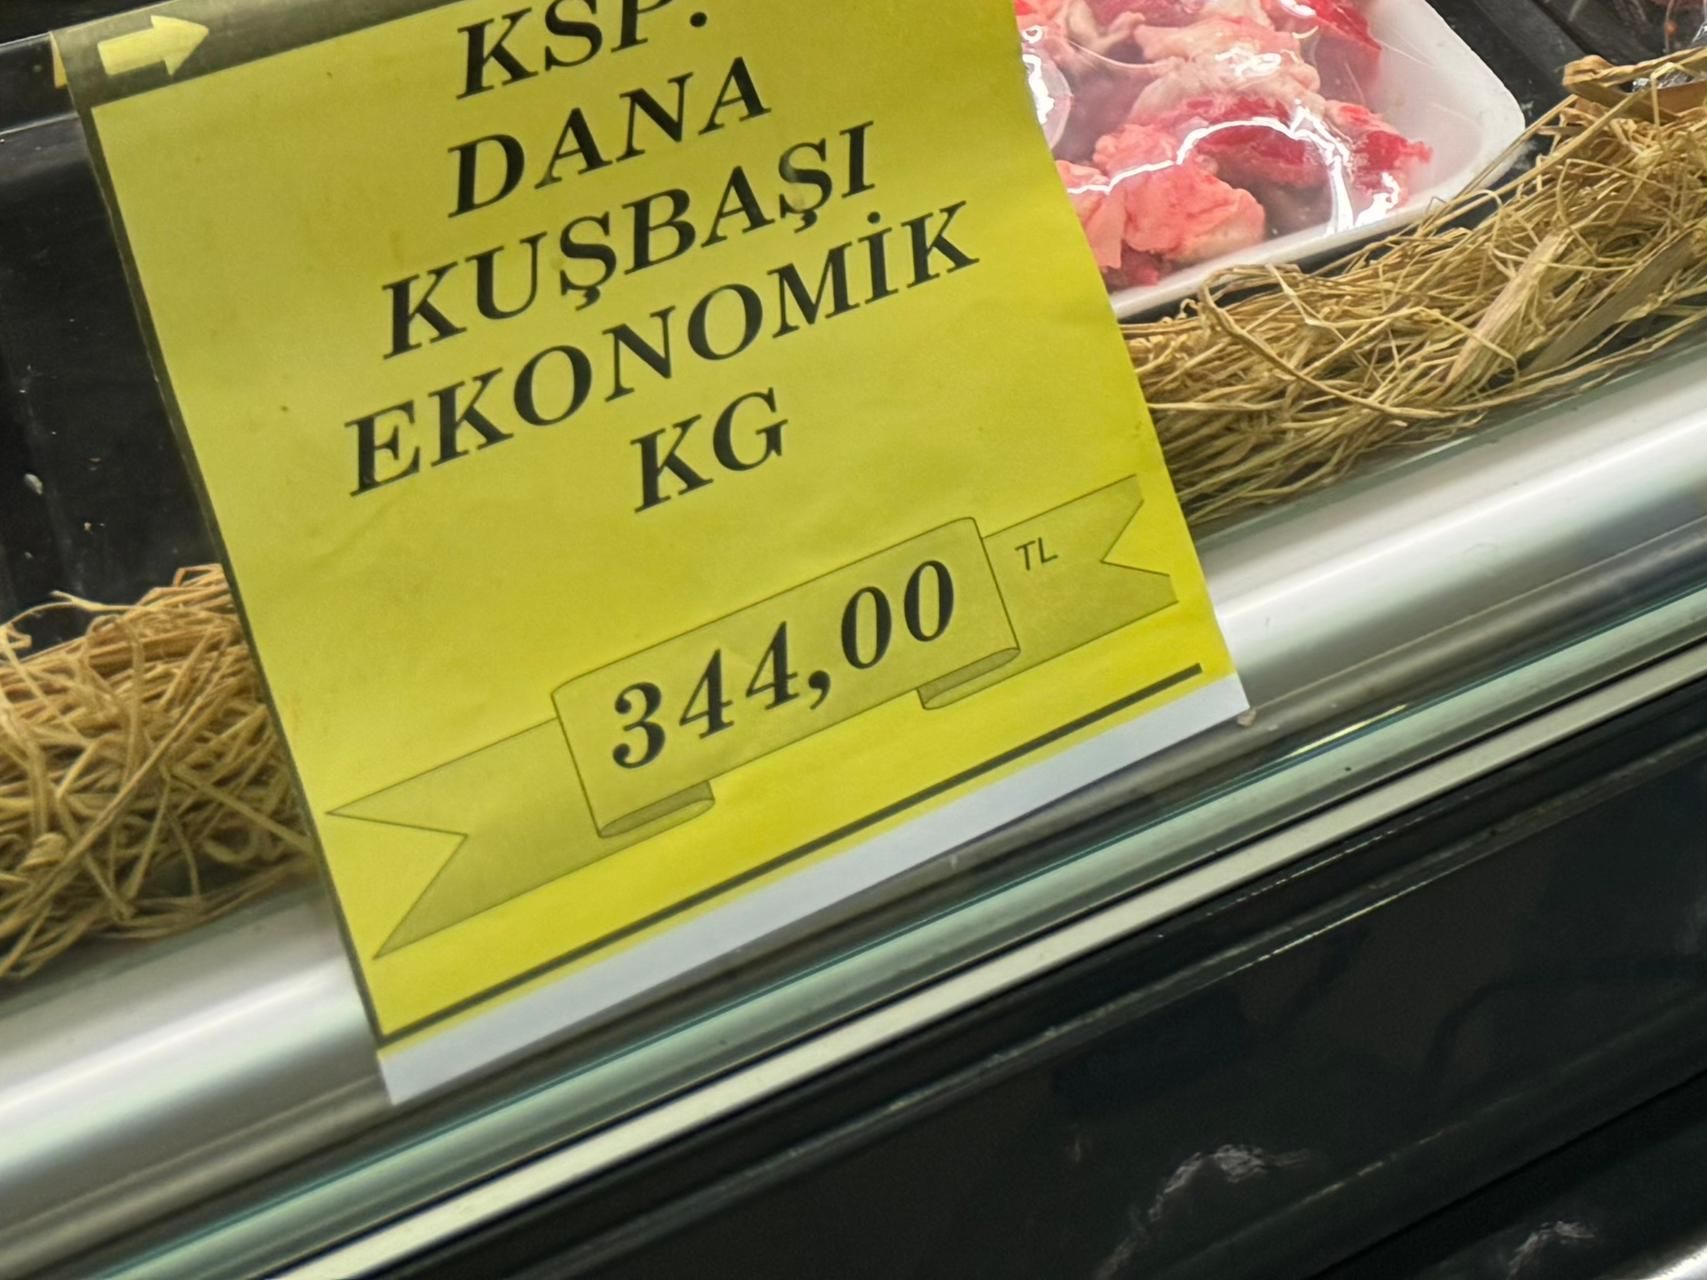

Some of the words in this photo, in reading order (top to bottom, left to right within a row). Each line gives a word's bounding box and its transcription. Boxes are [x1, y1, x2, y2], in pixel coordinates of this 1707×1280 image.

[446, 55, 773, 219] DANA
[381, 121, 876, 360] KUŞBAŞI
[345, 200, 979, 498] EKONOMİK
[633, 386, 790, 515] KG
[1015, 537, 1059, 573] TL
[610, 558, 956, 773] 344,00
